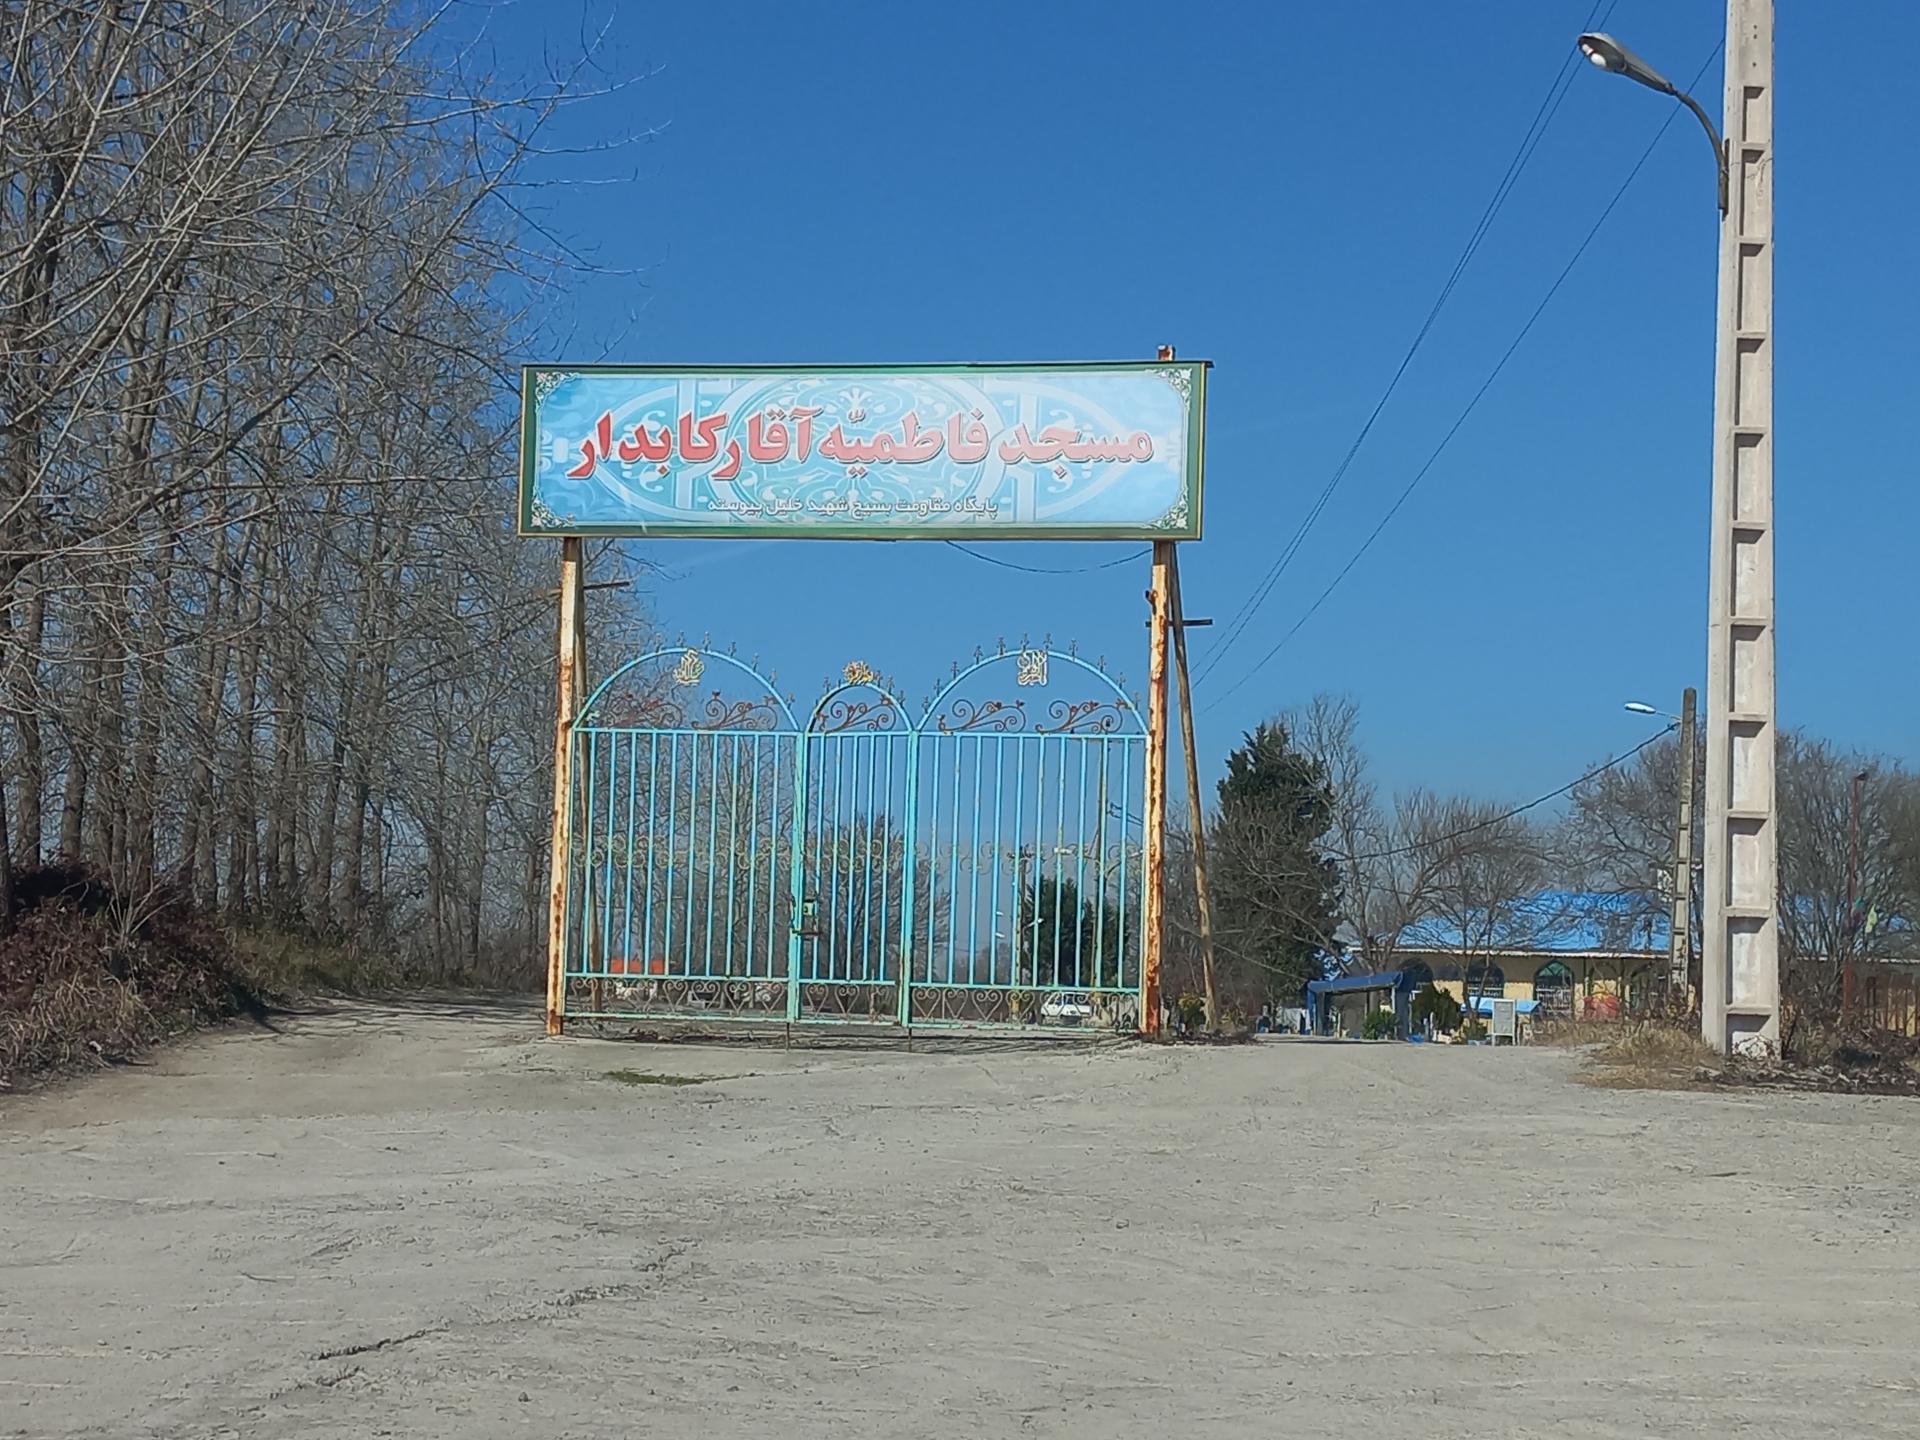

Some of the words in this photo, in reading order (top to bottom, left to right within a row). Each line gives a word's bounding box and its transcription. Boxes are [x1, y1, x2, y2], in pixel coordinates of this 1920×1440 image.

[998, 423, 1155, 480] مسجد
[765, 497, 804, 517] خلیل
[807, 496, 849, 516] شهید
[851, 499, 893, 520] بسیج
[895, 498, 951, 517] مقاومت
[953, 496, 999, 519] پایگاه
